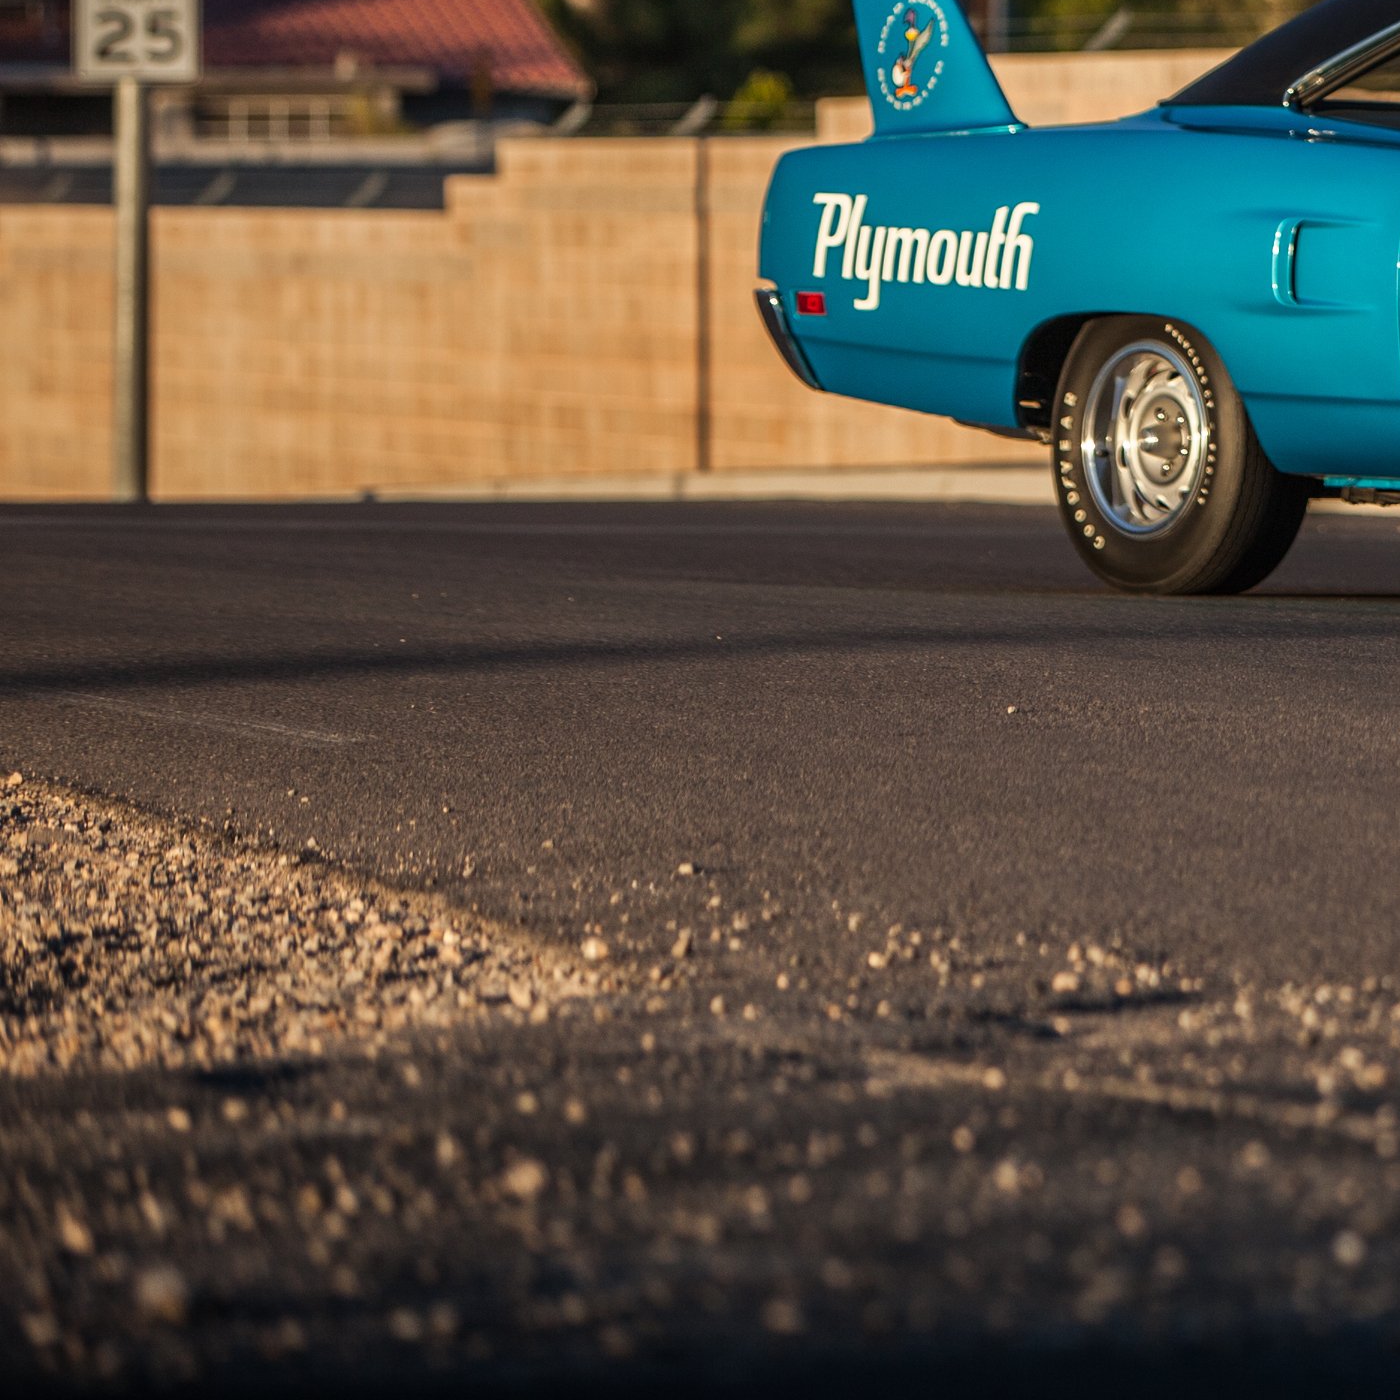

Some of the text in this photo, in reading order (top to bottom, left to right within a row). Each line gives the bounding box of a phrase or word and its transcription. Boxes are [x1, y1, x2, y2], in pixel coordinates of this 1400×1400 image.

[94, 10, 183, 63] 25
[812, 192, 1040, 310] Plymouth
[1059, 391, 1106, 550] GOODYEAR
